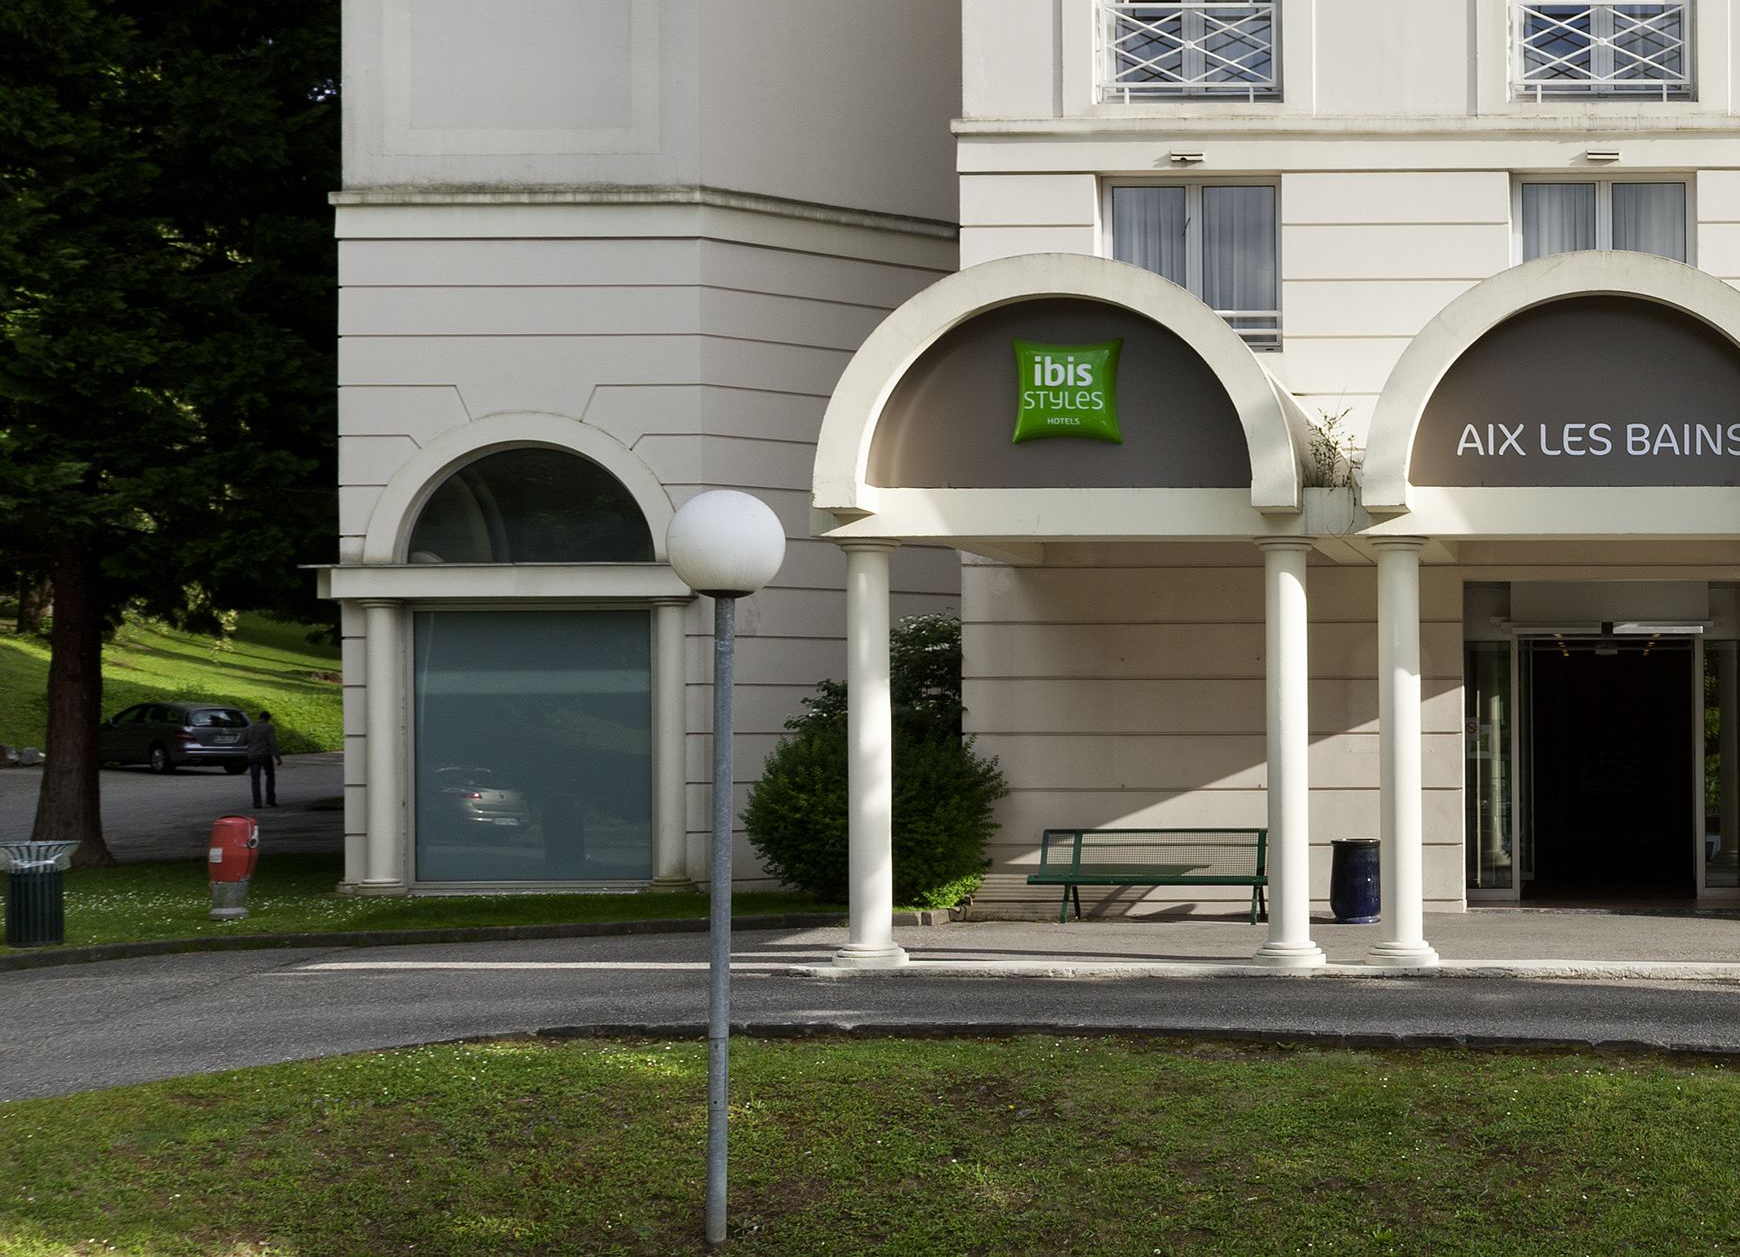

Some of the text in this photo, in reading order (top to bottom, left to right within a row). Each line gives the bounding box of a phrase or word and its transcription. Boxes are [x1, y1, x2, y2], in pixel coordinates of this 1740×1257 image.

[1034, 356, 1093, 386] ibis
[1047, 417, 1080, 425] HOTELS
[1456, 423, 1526, 456] AIX
[1540, 423, 1612, 456] LES
